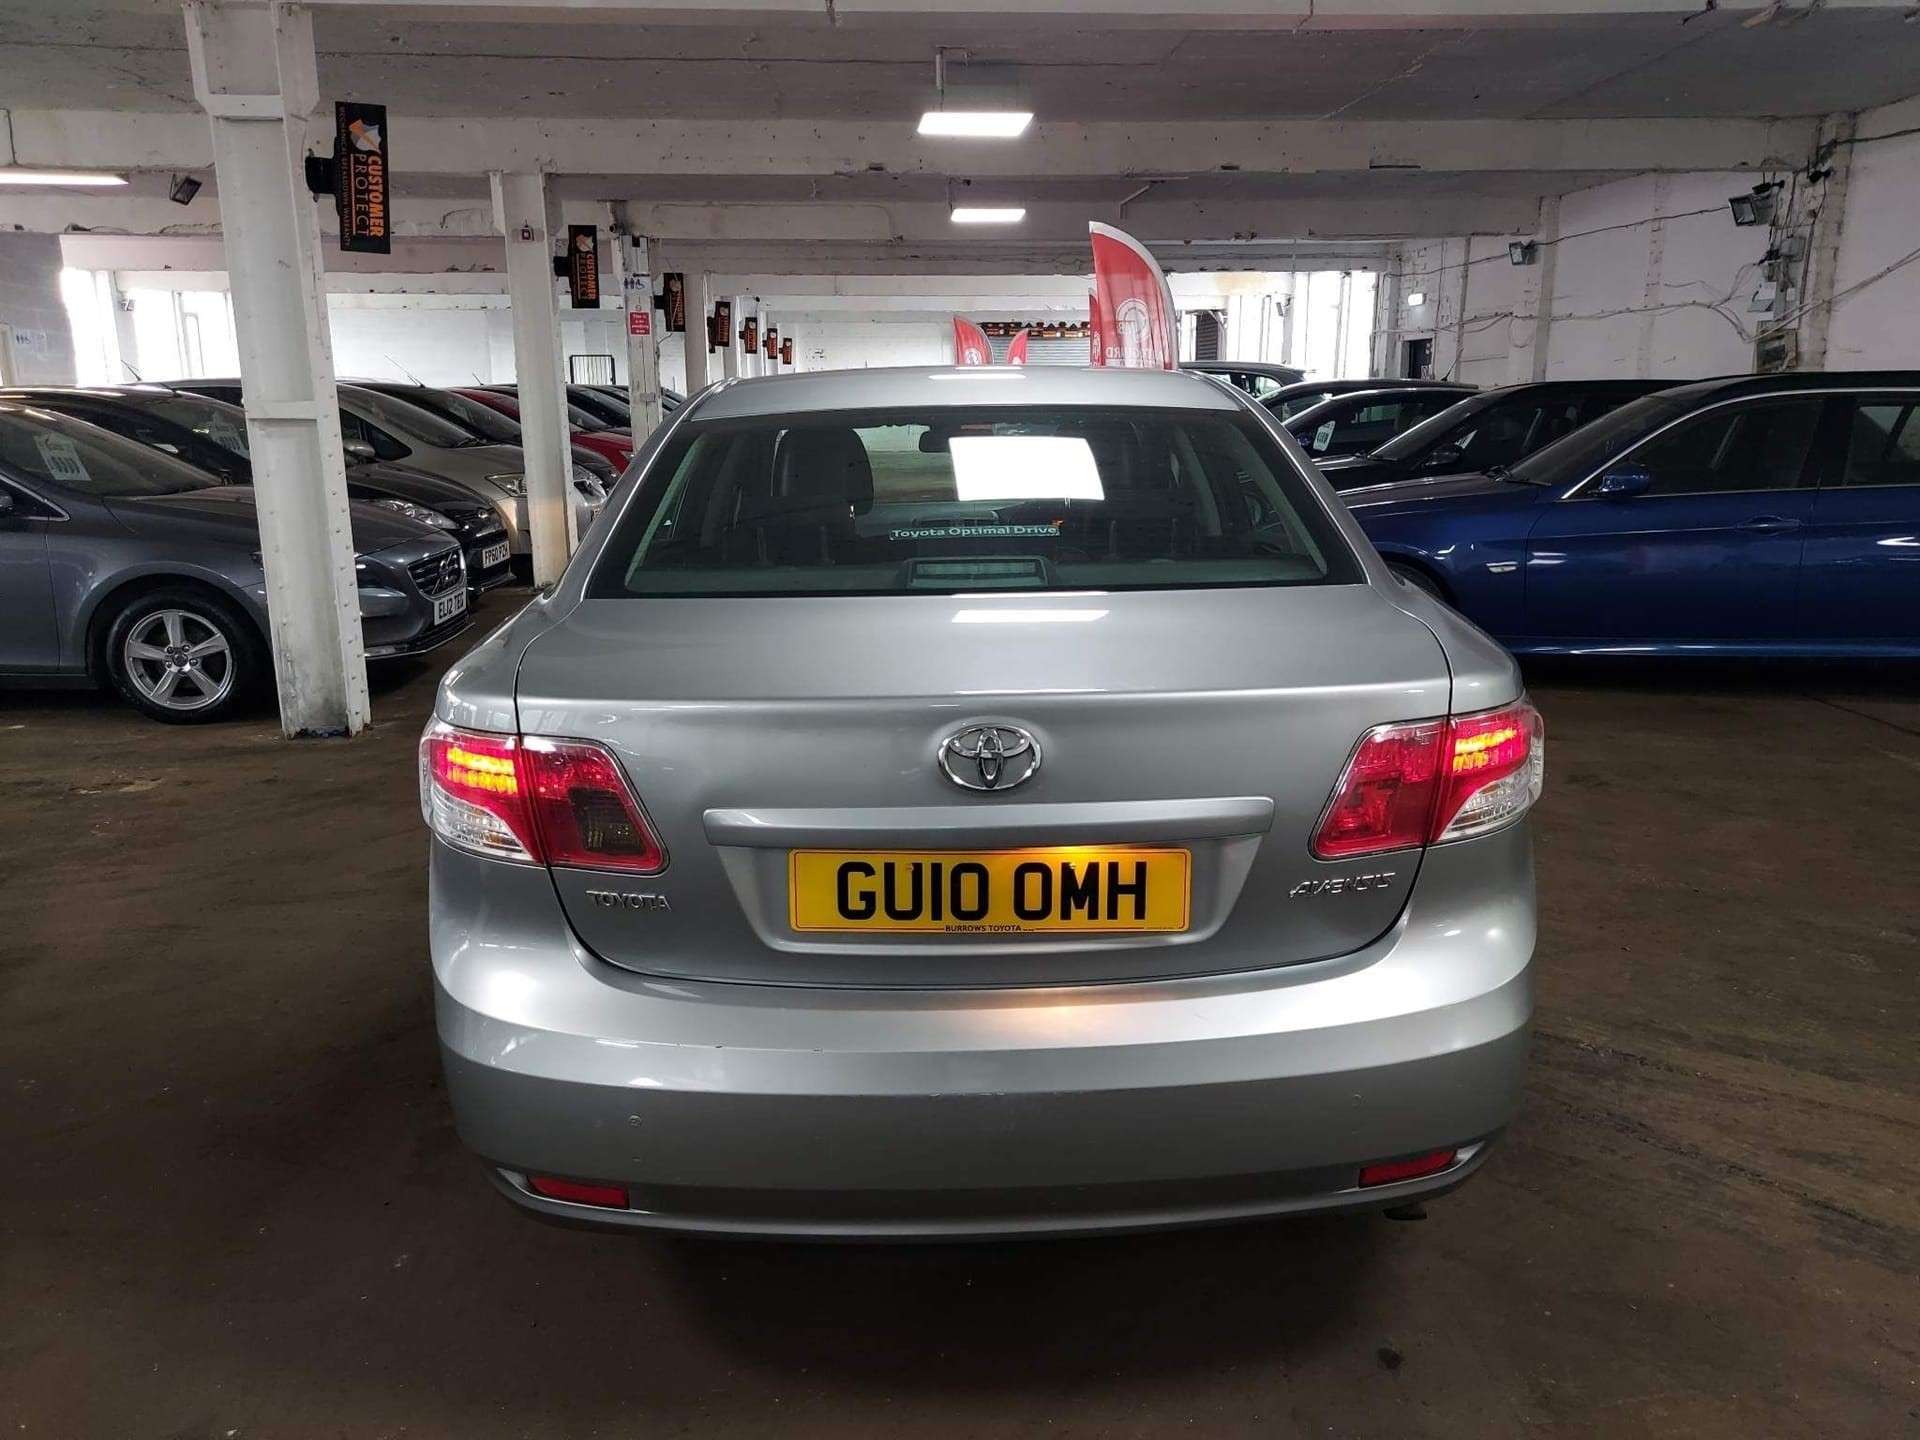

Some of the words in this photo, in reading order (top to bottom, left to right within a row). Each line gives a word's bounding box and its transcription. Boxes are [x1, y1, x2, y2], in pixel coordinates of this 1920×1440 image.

[355, 153, 369, 237] PROTECT
[368, 154, 386, 240] CUSTOMER
[892, 529, 945, 539] Toyota
[948, 526, 1010, 538] Optimal
[1014, 526, 1058, 536] Drive
[836, 861, 990, 922] GU10
[1013, 861, 1148, 921] OMH
[1288, 872, 1396, 898] AVENSIS
[586, 890, 671, 911] TOYOTA
[945, 924, 986, 932] BURROWS
[988, 924, 1021, 932] TOYOTA
